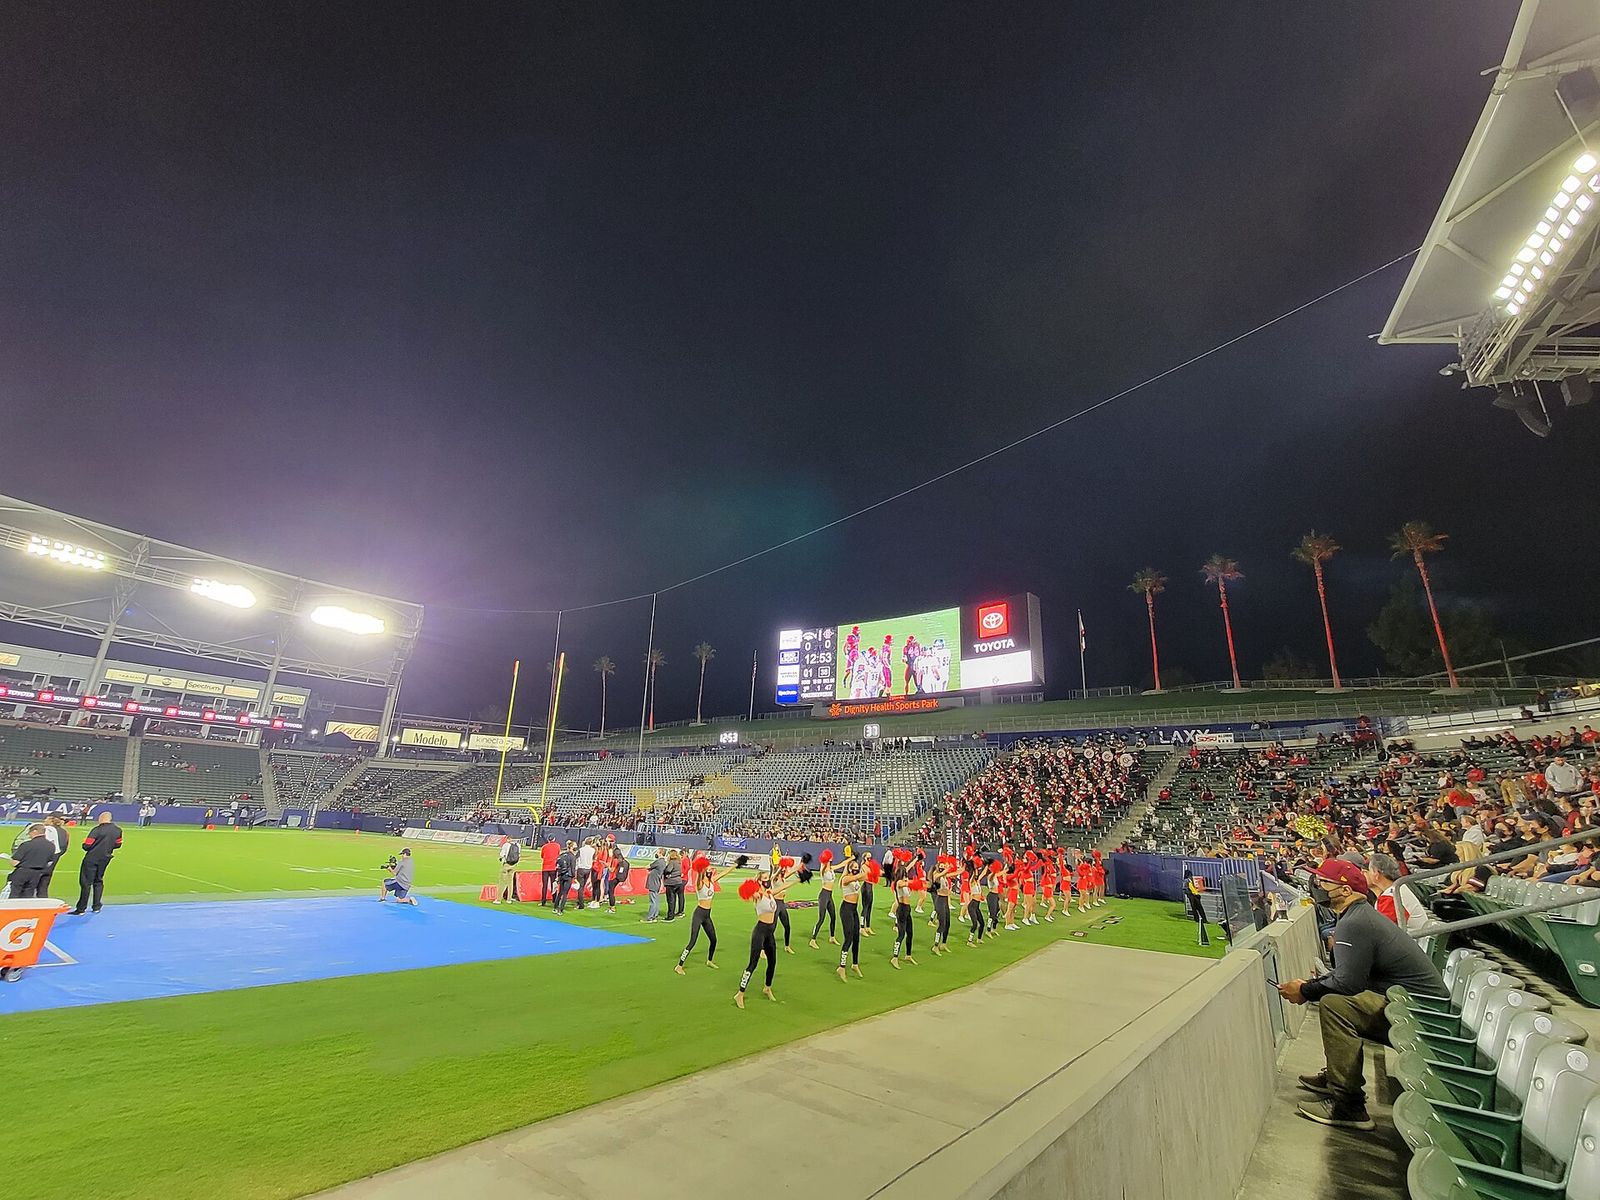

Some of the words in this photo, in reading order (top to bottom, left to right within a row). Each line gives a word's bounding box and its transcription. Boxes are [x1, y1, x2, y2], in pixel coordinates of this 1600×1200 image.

[805, 642, 811, 650] 0
[825, 640, 831, 648] 0
[974, 639, 1015, 653] TOYOTA
[805, 653, 832, 664] 12:53
[188, 682, 219, 691] Spectrum
[844, 705, 869, 715] Dignity
[871, 702, 894, 711] Health
[895, 701, 920, 711] Sports
[922, 699, 938, 708] Park
[413, 733, 448, 746] Modelo
[720, 732, 738, 743] 12:53
[636, 847, 658, 858] COX
[0, 907, 39, 952] G
[740, 970, 751, 988] SDSU
